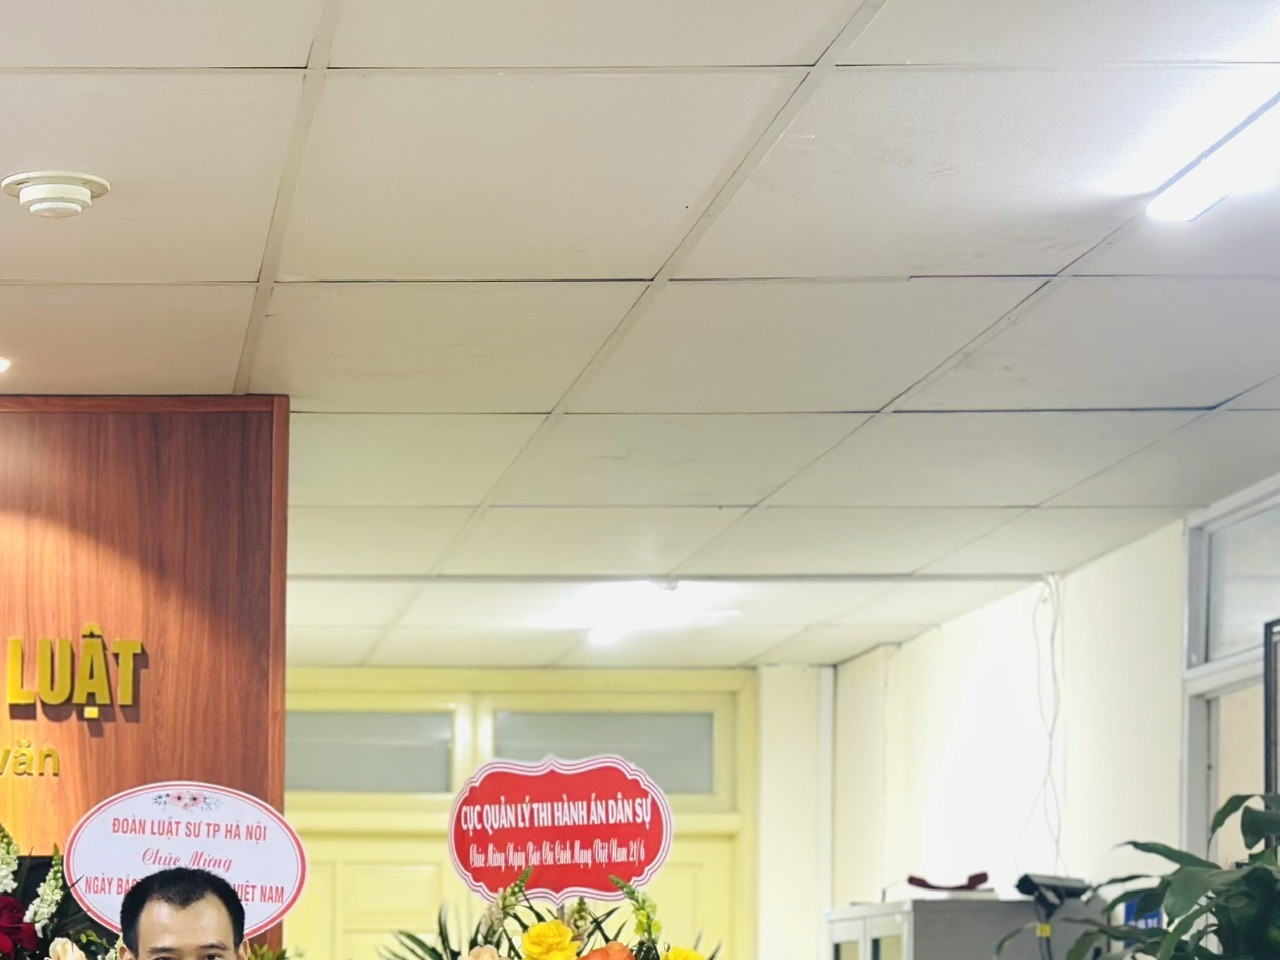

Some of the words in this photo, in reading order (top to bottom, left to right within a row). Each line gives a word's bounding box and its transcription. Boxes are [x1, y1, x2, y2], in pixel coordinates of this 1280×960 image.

[7, 622, 143, 719] LUẬT
[112, 814, 147, 836] ĐOÀN
[150, 816, 181, 840] LUẬT
[185, 820, 202, 838] SƯ
[205, 822, 221, 839] TP
[224, 819, 242, 841] HÀ
[245, 820, 268, 845] NỘI
[461, 804, 482, 836] CỤC
[482, 796, 516, 835] QUẢN
[517, 796, 531, 829] LÝ
[532, 802, 552, 828] THI
[553, 794, 588, 827] HÀNH
[589, 792, 607, 826] ÁN
[608, 791, 634, 825] DÂN
[635, 794, 652, 830] SỰ
[141, 847, 181, 867] Chúc
[185, 849, 233, 873] Mừng
[628, 837, 646, 868] 21/6
[85, 872, 113, 895] NGÀY
[233, 880, 257, 906] VIỆT
[260, 885, 284, 904] NAM
